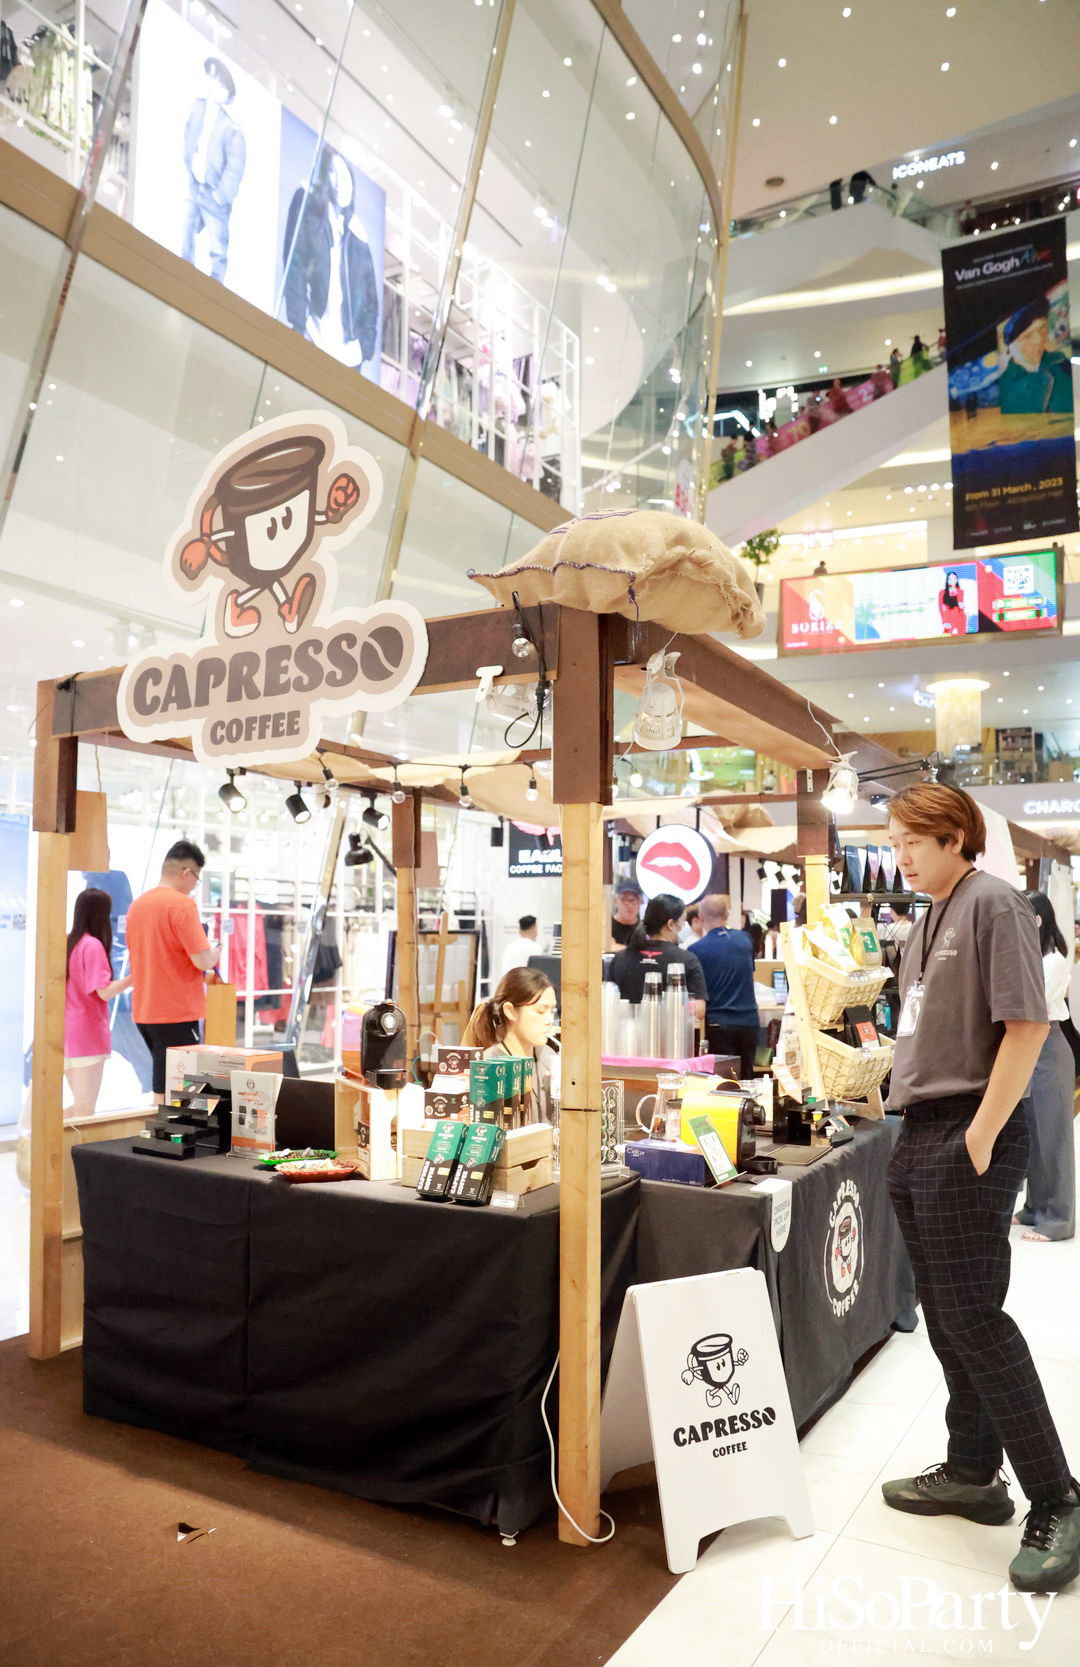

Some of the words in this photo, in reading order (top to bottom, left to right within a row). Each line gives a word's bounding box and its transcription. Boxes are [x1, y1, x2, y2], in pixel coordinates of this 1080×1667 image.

[893, 150, 966, 180] ICONEATS
[954, 267, 980, 282] Van
[982, 256, 1019, 276] Gogh
[965, 490, 990, 501] From
[991, 487, 1001, 498] 31
[1002, 483, 1032, 495] March
[1038, 477, 1063, 490] 2023
[132, 625, 404, 717] CAPRESSO
[209, 709, 301, 746] COFFEE
[509, 864, 544, 875] COFFEE
[545, 864, 563, 874] FAC
[417, 1160, 431, 1191] CAPSULE
[424, 1166, 436, 1192] COFFEE
[450, 1164, 464, 1195] CAPSULE
[456, 1170, 469, 1196] COFFEE
[775, 1223, 787, 1238] HERE
[673, 1406, 777, 1447] CAPRESSO
[712, 1441, 748, 1458] COFFEE
